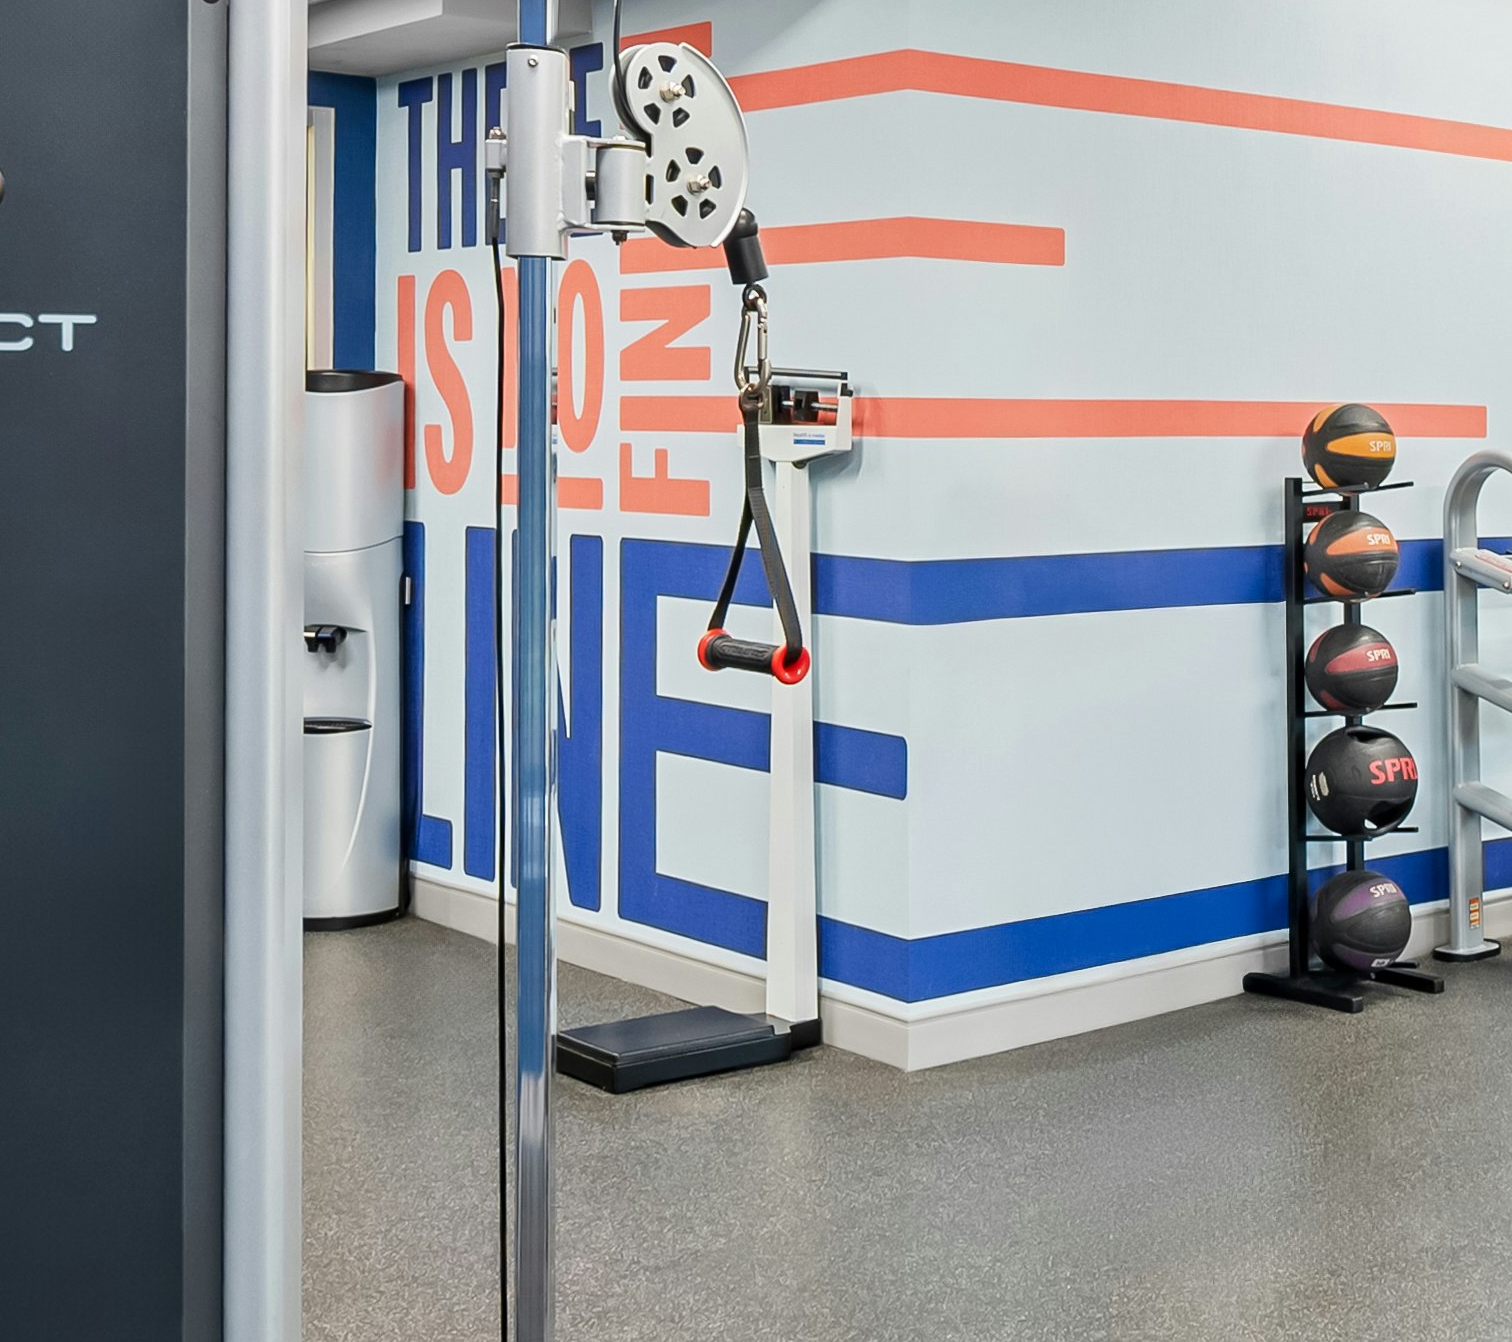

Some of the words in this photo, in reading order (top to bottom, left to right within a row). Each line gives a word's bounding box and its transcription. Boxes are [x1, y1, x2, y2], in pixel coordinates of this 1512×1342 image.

[398, 42, 604, 252] THE
[397, 269, 473, 495] IS
[1369, 441, 1392, 452] SPRI
[1367, 534, 1390, 546] SPRI
[1367, 649, 1391, 662] SPRI
